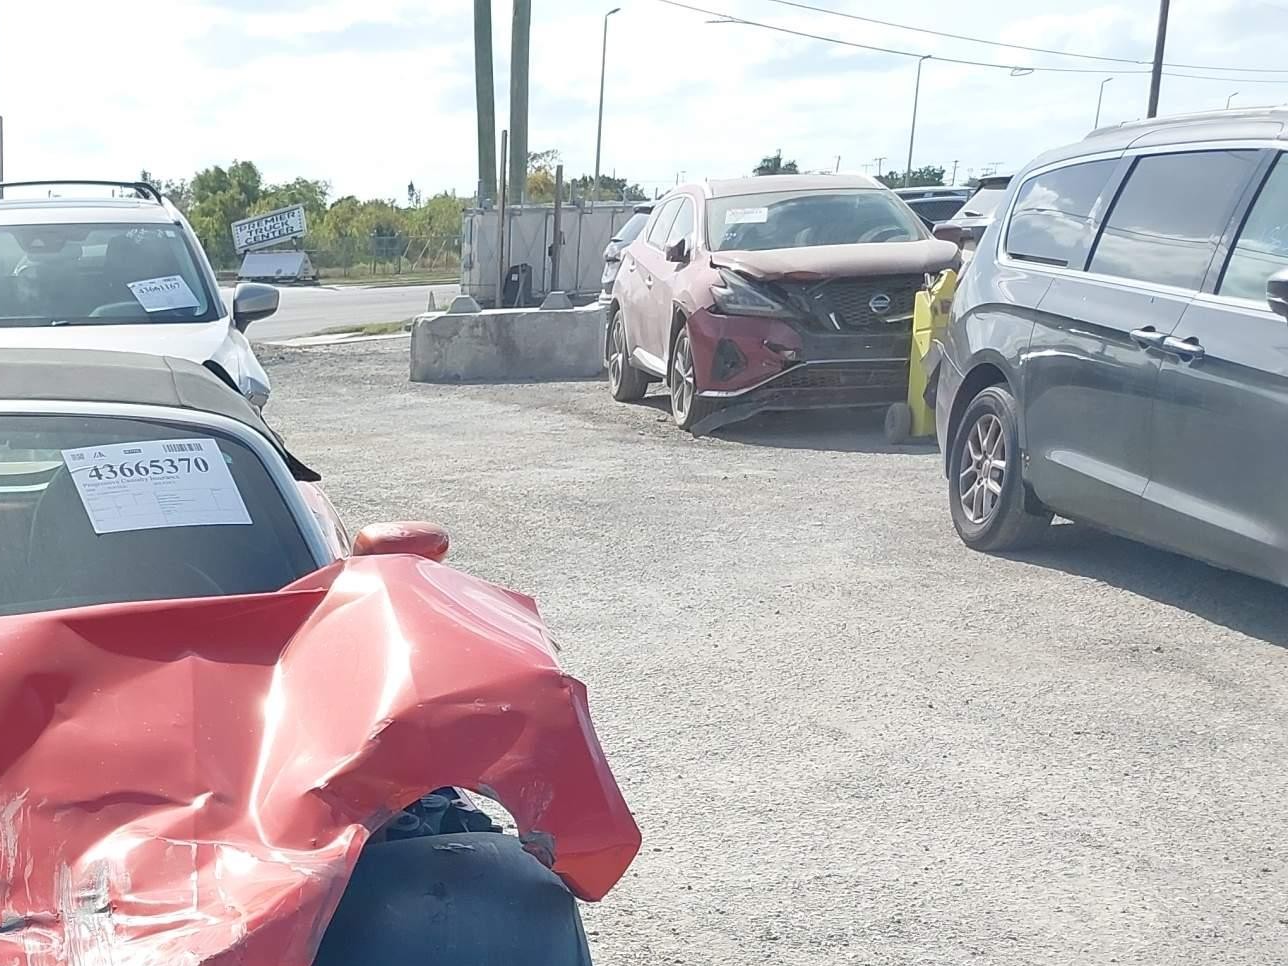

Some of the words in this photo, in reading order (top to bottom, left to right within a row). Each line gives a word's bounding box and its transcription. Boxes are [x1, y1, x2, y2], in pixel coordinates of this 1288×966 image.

[239, 211, 296, 233] PREMIER
[247, 222, 290, 237] TRUCK
[245, 226, 294, 245] CENTER
[88, 456, 210, 481] 43665370
